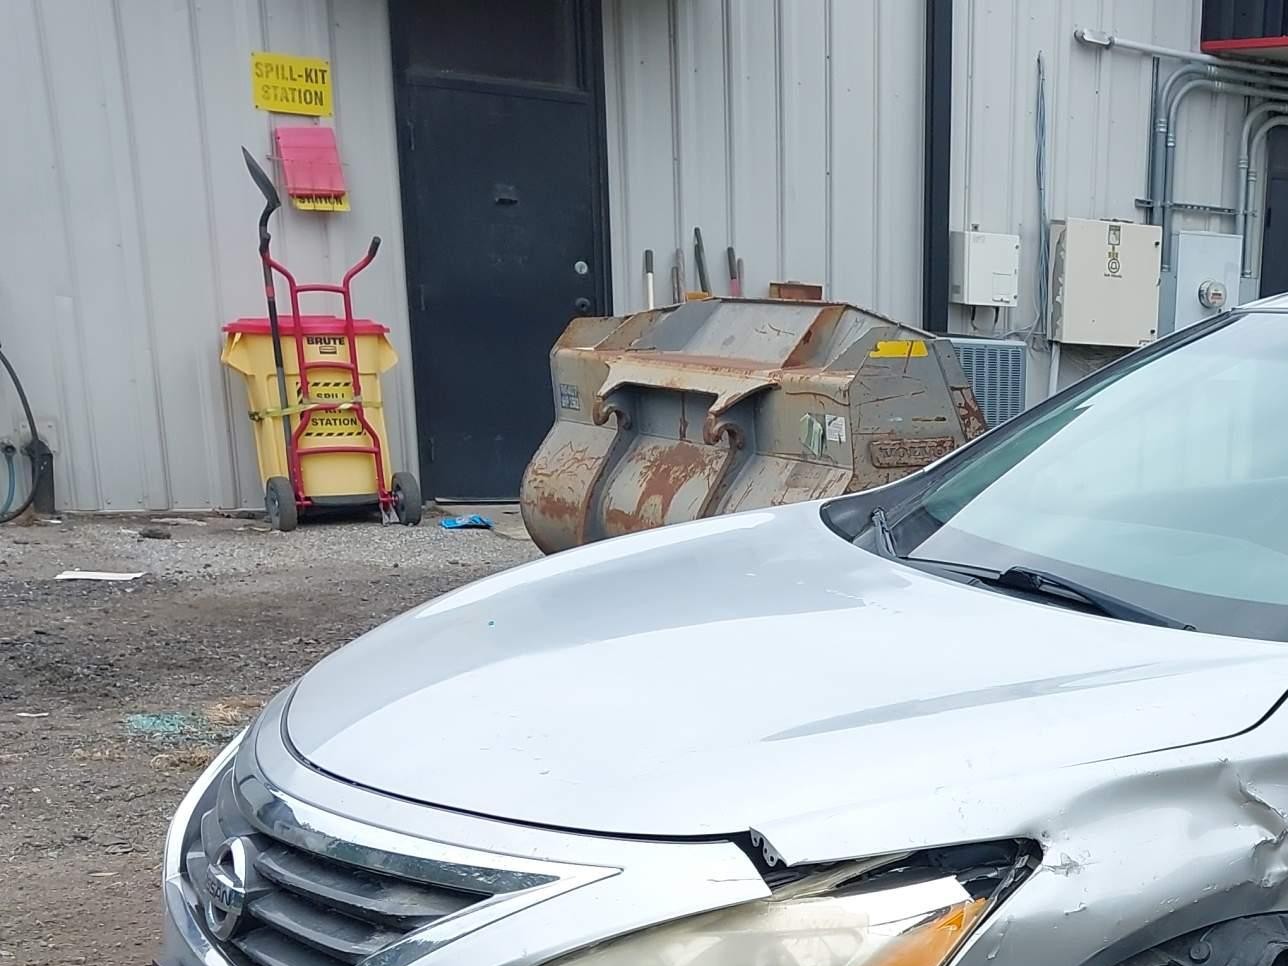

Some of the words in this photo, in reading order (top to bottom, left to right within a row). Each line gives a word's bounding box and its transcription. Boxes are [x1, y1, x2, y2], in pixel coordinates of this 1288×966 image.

[255, 61, 328, 85] SPILL-KIT
[262, 84, 324, 107] STATION
[306, 335, 345, 346] BRUTE
[311, 417, 358, 427] STATION
